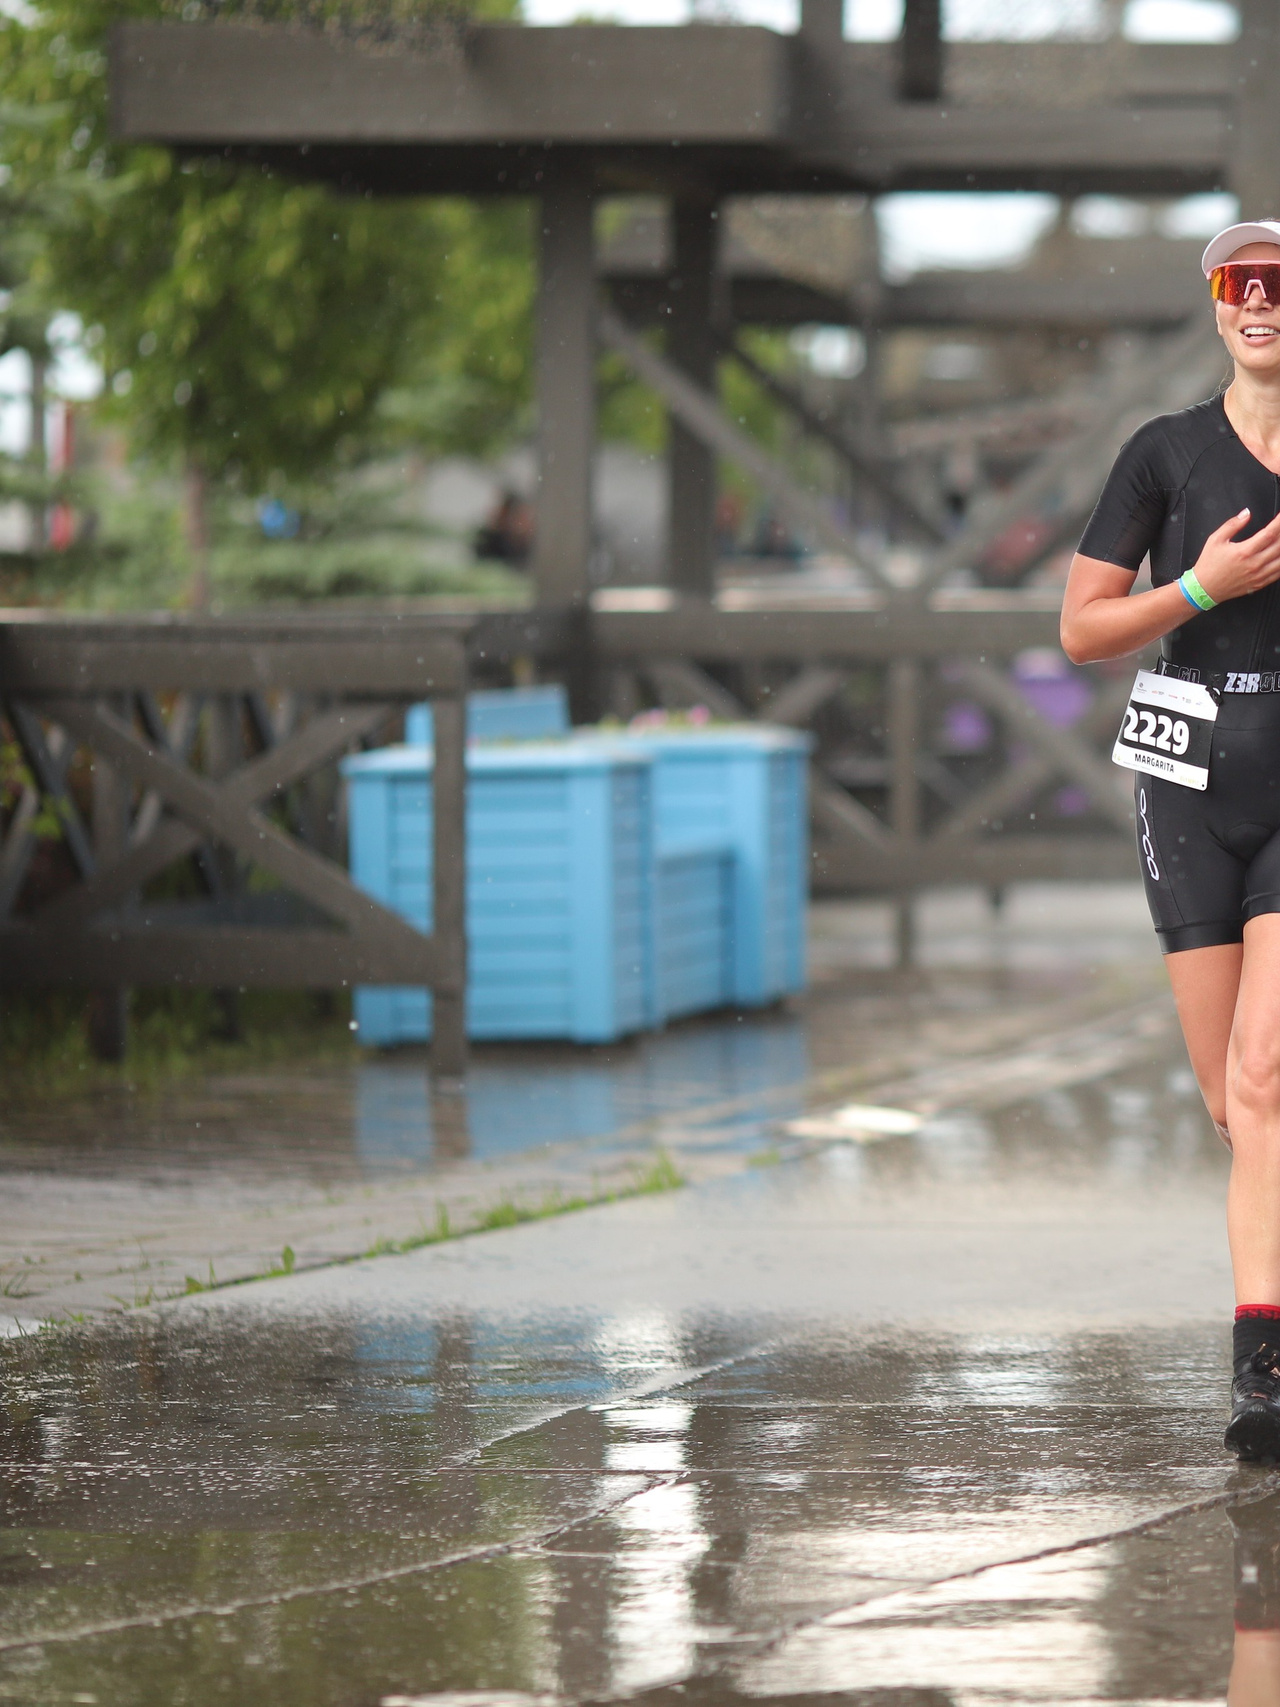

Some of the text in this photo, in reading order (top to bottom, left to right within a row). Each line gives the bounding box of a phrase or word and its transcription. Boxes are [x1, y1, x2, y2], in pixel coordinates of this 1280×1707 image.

[1123, 706, 1190, 756] 2229
[1134, 753, 1175, 774] MARGARITA
[1139, 787, 1160, 882] orca
